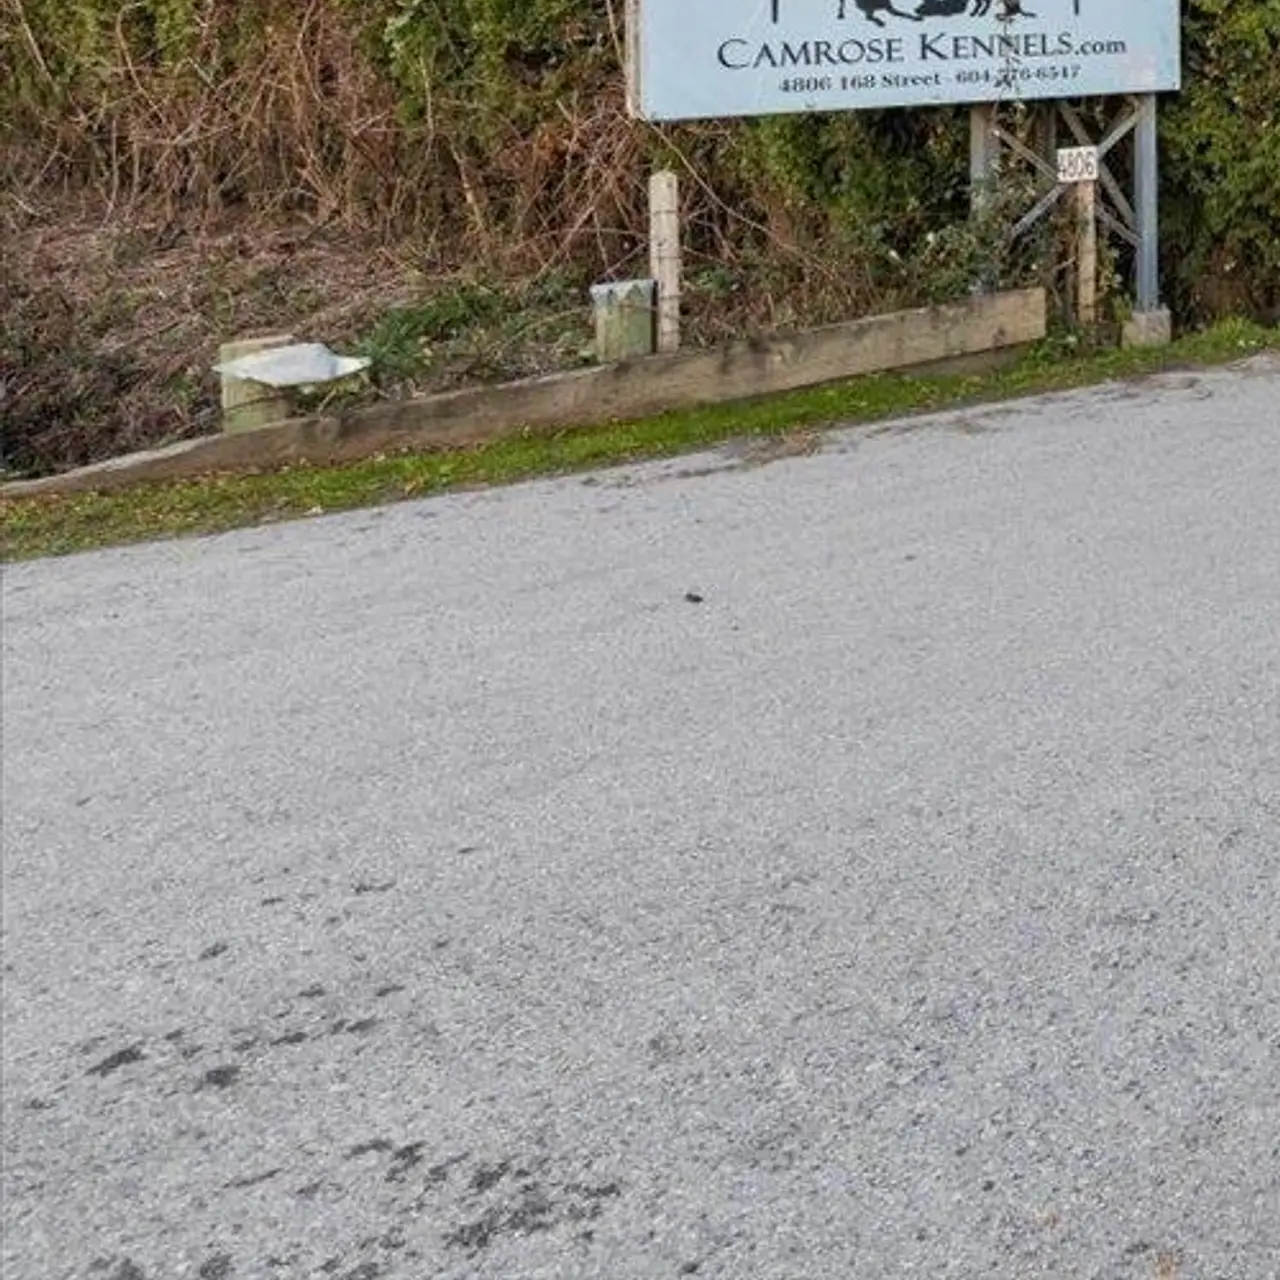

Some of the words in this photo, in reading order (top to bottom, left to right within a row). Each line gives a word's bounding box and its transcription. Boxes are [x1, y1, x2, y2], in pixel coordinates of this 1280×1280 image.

[779, 76, 832, 93] 4806
[840, 74, 876, 91] 168
[881, 73, 942, 88] Street
[1057, 150, 1095, 177] 4806
